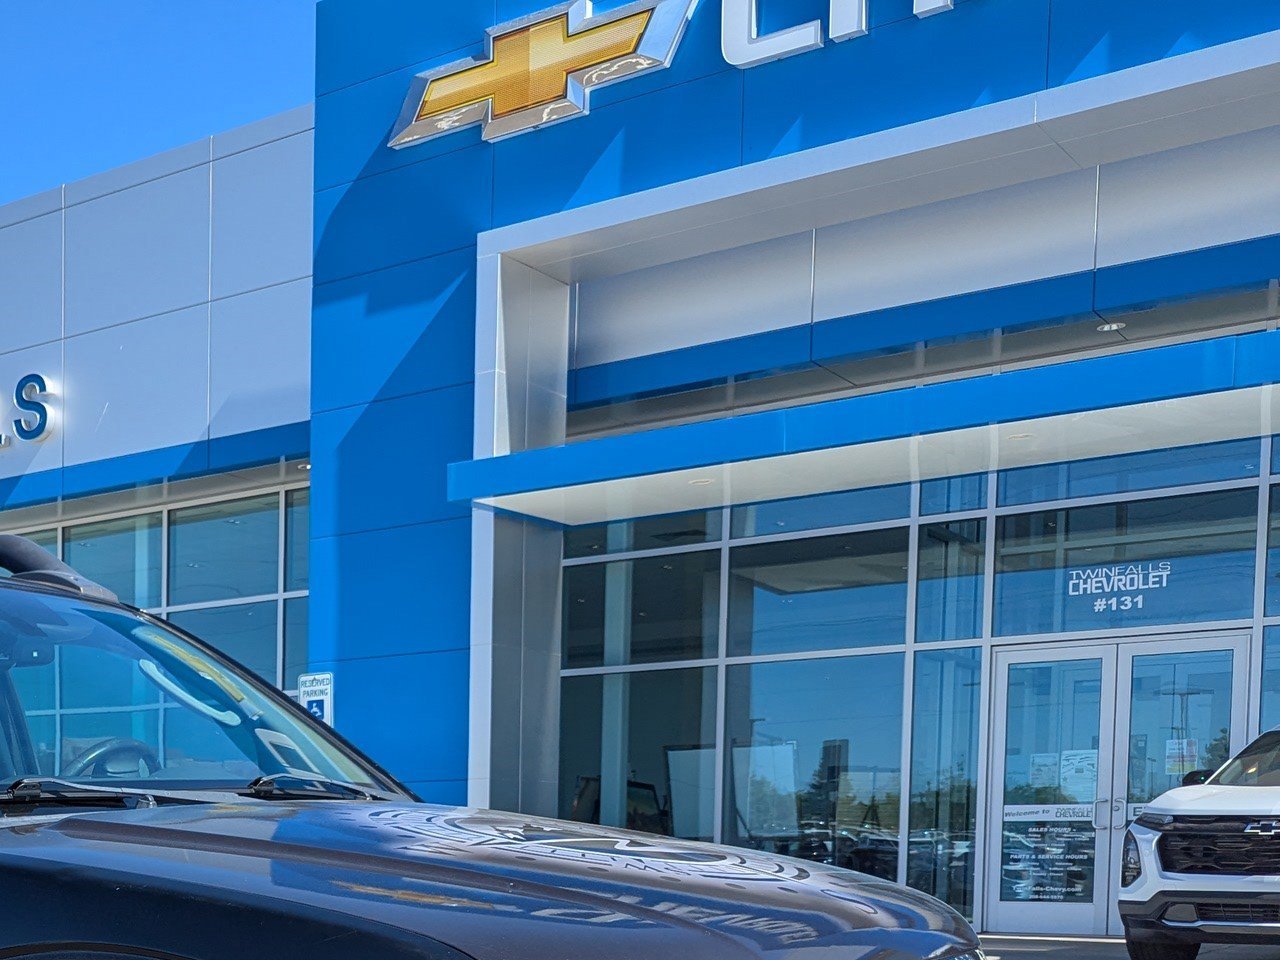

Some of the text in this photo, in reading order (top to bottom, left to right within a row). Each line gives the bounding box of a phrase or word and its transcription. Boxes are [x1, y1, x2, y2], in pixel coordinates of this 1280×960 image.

[1069, 562, 1171, 580] TWINFALLS
[1069, 571, 1171, 595] CHEVROLET
[1094, 595, 1144, 612] #131
[300, 677, 330, 688] RESERVED
[303, 689, 328, 698] PARKING
[1005, 809, 1040, 817] Welcome
[1055, 810, 1093, 818] CHEVROLE
